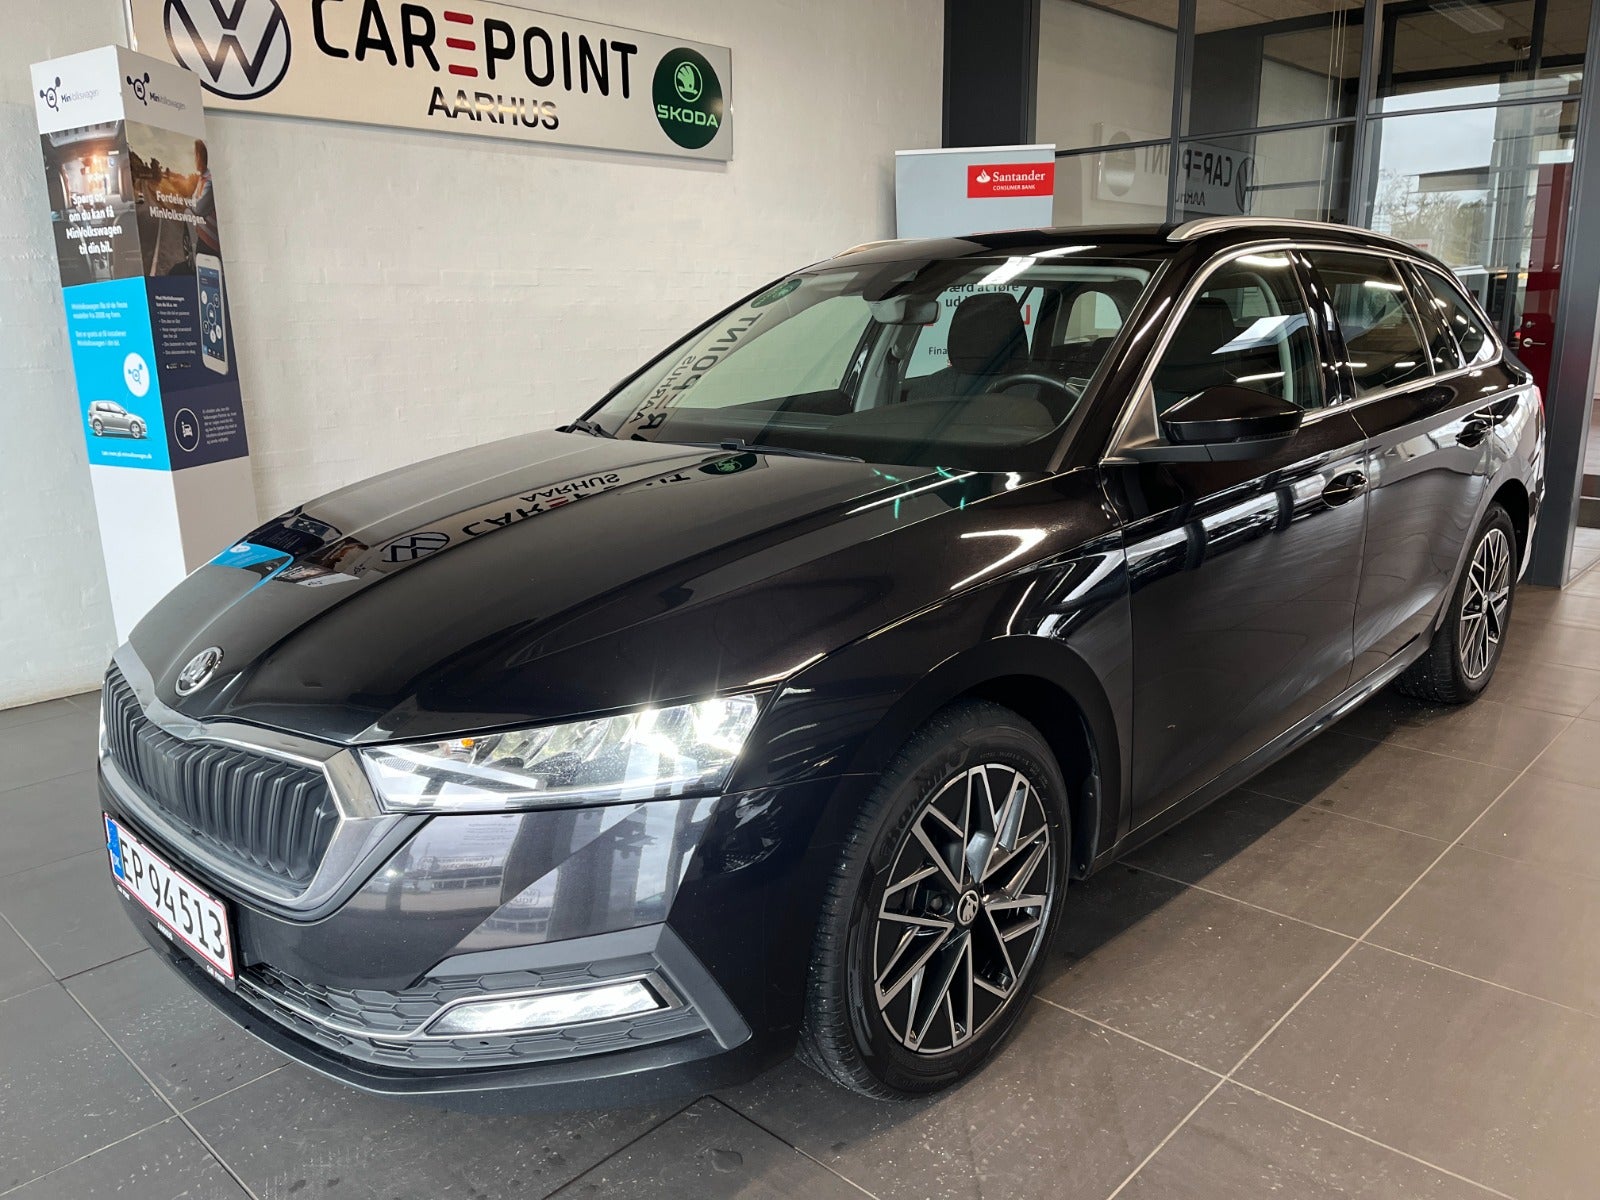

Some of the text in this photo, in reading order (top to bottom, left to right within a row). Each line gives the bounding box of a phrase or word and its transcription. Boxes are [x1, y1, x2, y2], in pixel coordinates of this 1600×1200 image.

[427, 86, 559, 130] AARHUS
[992, 169, 1046, 182] Santander
[156, 190, 184, 206] Fordele
[69, 204, 115, 222] om du kan få
[149, 205, 207, 226] MinVolkswagen.
[66, 225, 122, 239] MinVolkswagen
[79, 240, 113, 255] til din bil.
[943, 280, 974, 292] ærd
[928, 346, 948, 355] Fina
[120, 837, 226, 960] EP 94513
